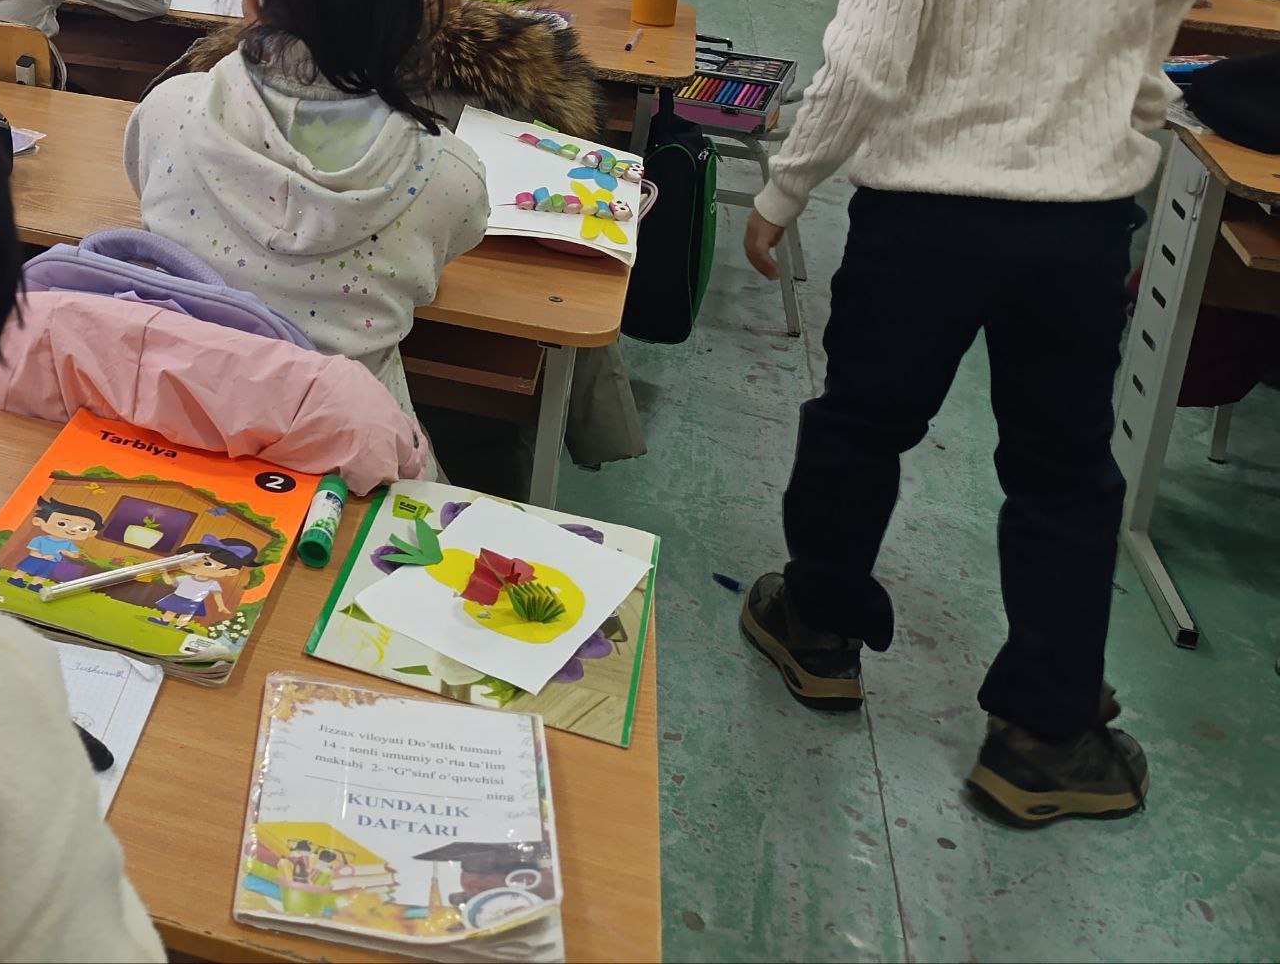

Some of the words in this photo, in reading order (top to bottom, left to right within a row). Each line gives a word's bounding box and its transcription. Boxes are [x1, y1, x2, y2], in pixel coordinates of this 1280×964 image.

[99, 429, 179, 461] Tarbiya
[266, 475, 284, 491] 2
[318, 723, 355, 738] Jizzax
[359, 732, 404, 747] viloyati
[408, 737, 456, 752] Do'stlik
[460, 744, 502, 756] tumani
[323, 738, 337, 749] 14
[348, 745, 379, 757] sonli
[382, 750, 431, 766] umumiy
[314, 752, 364, 771] maktabi
[438, 771, 505, 786] o'quvchisi
[347, 792, 471, 819] KUNDALIK
[486, 792, 516, 804] ning
[357, 814, 459, 837] DAFTARI
